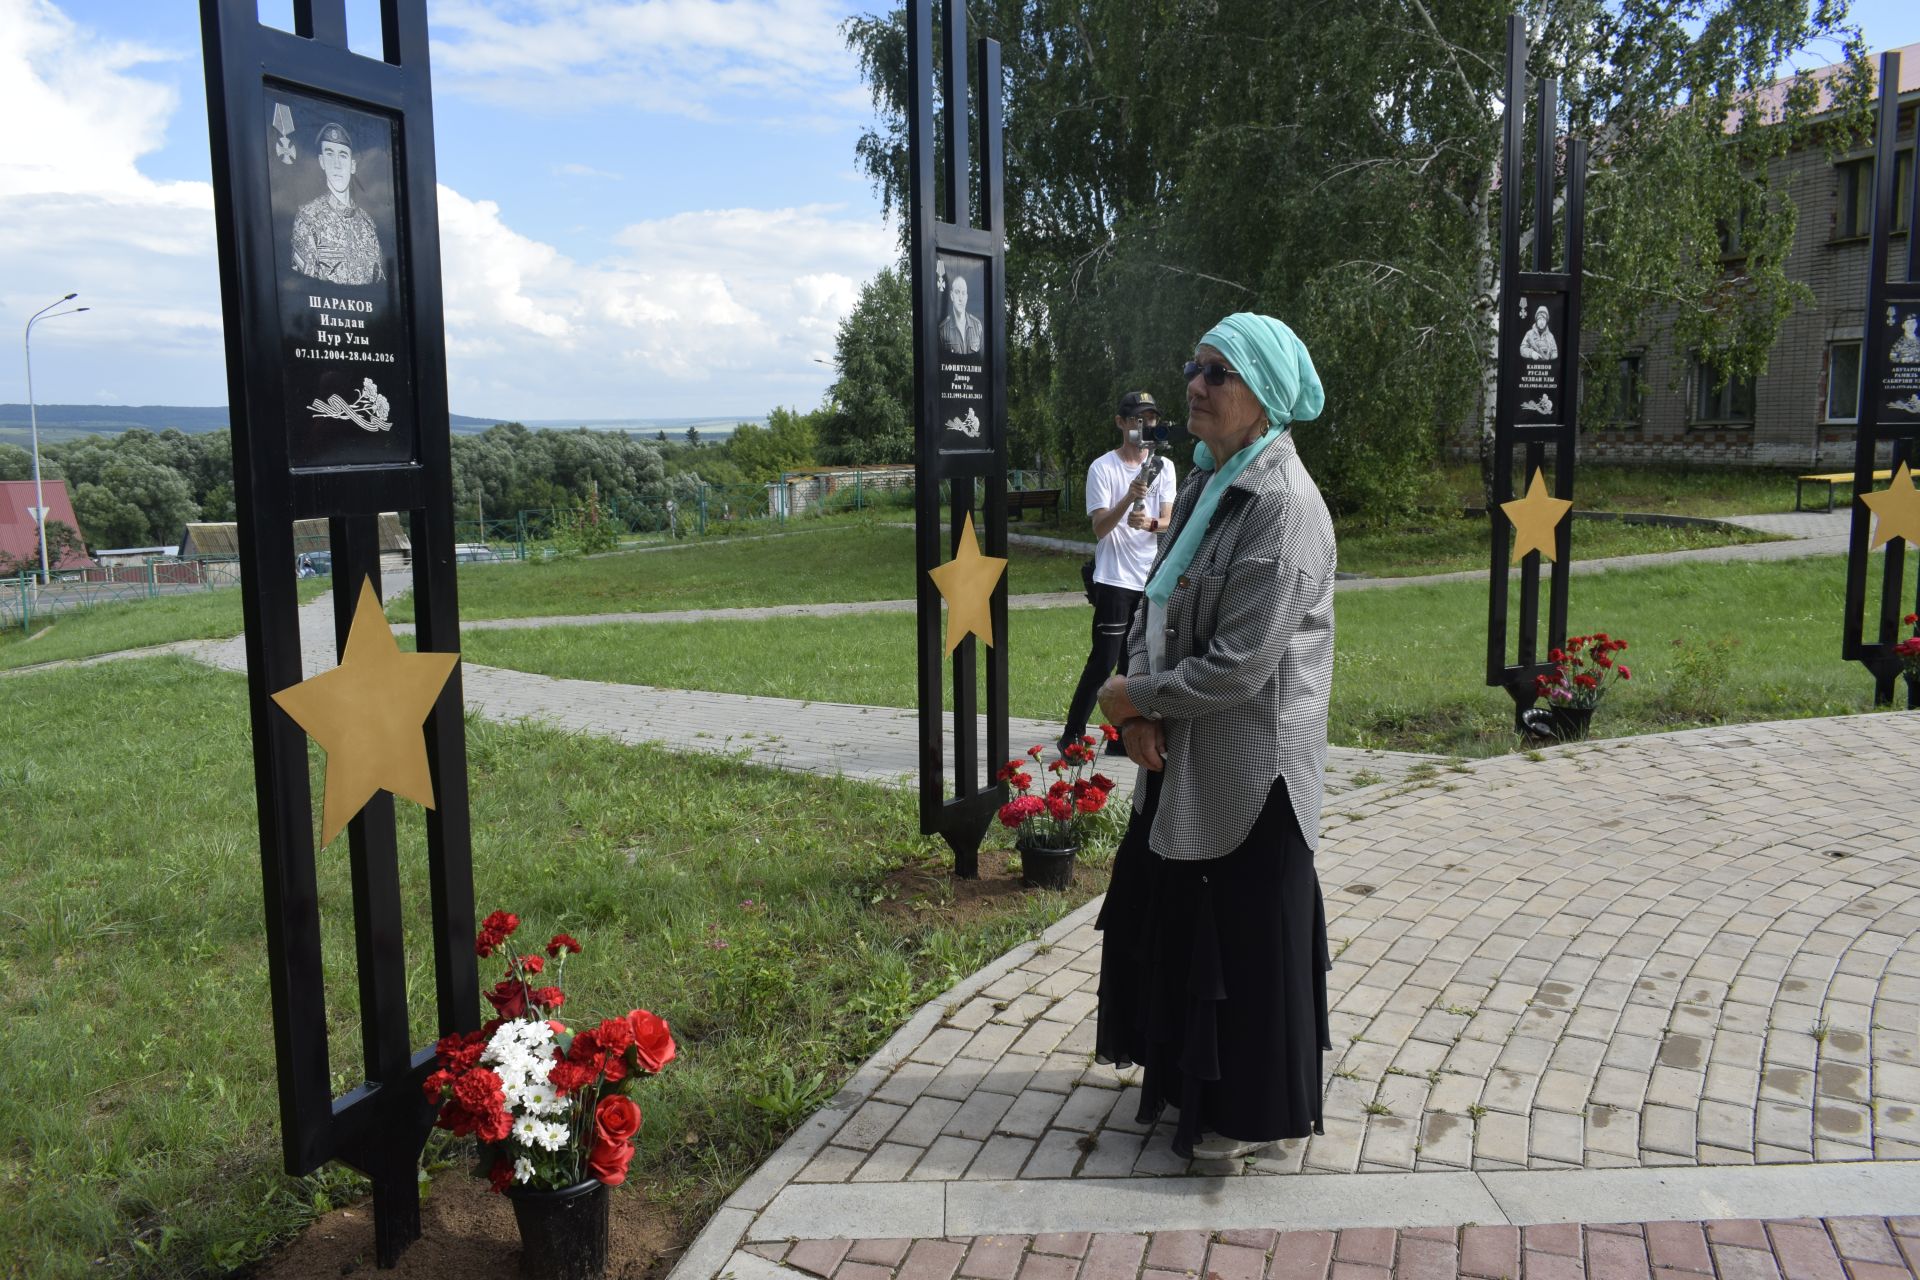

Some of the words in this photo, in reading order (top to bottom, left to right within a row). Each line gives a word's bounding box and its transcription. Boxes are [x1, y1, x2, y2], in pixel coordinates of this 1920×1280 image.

[308, 295, 373, 313] ШАРАКОВ
[319, 313, 365, 329] Ильдан
[317, 330, 342, 346] Нур
[345, 332, 370, 345] Улы
[295, 348, 395, 363] 07.11.2004-28.04.2026
